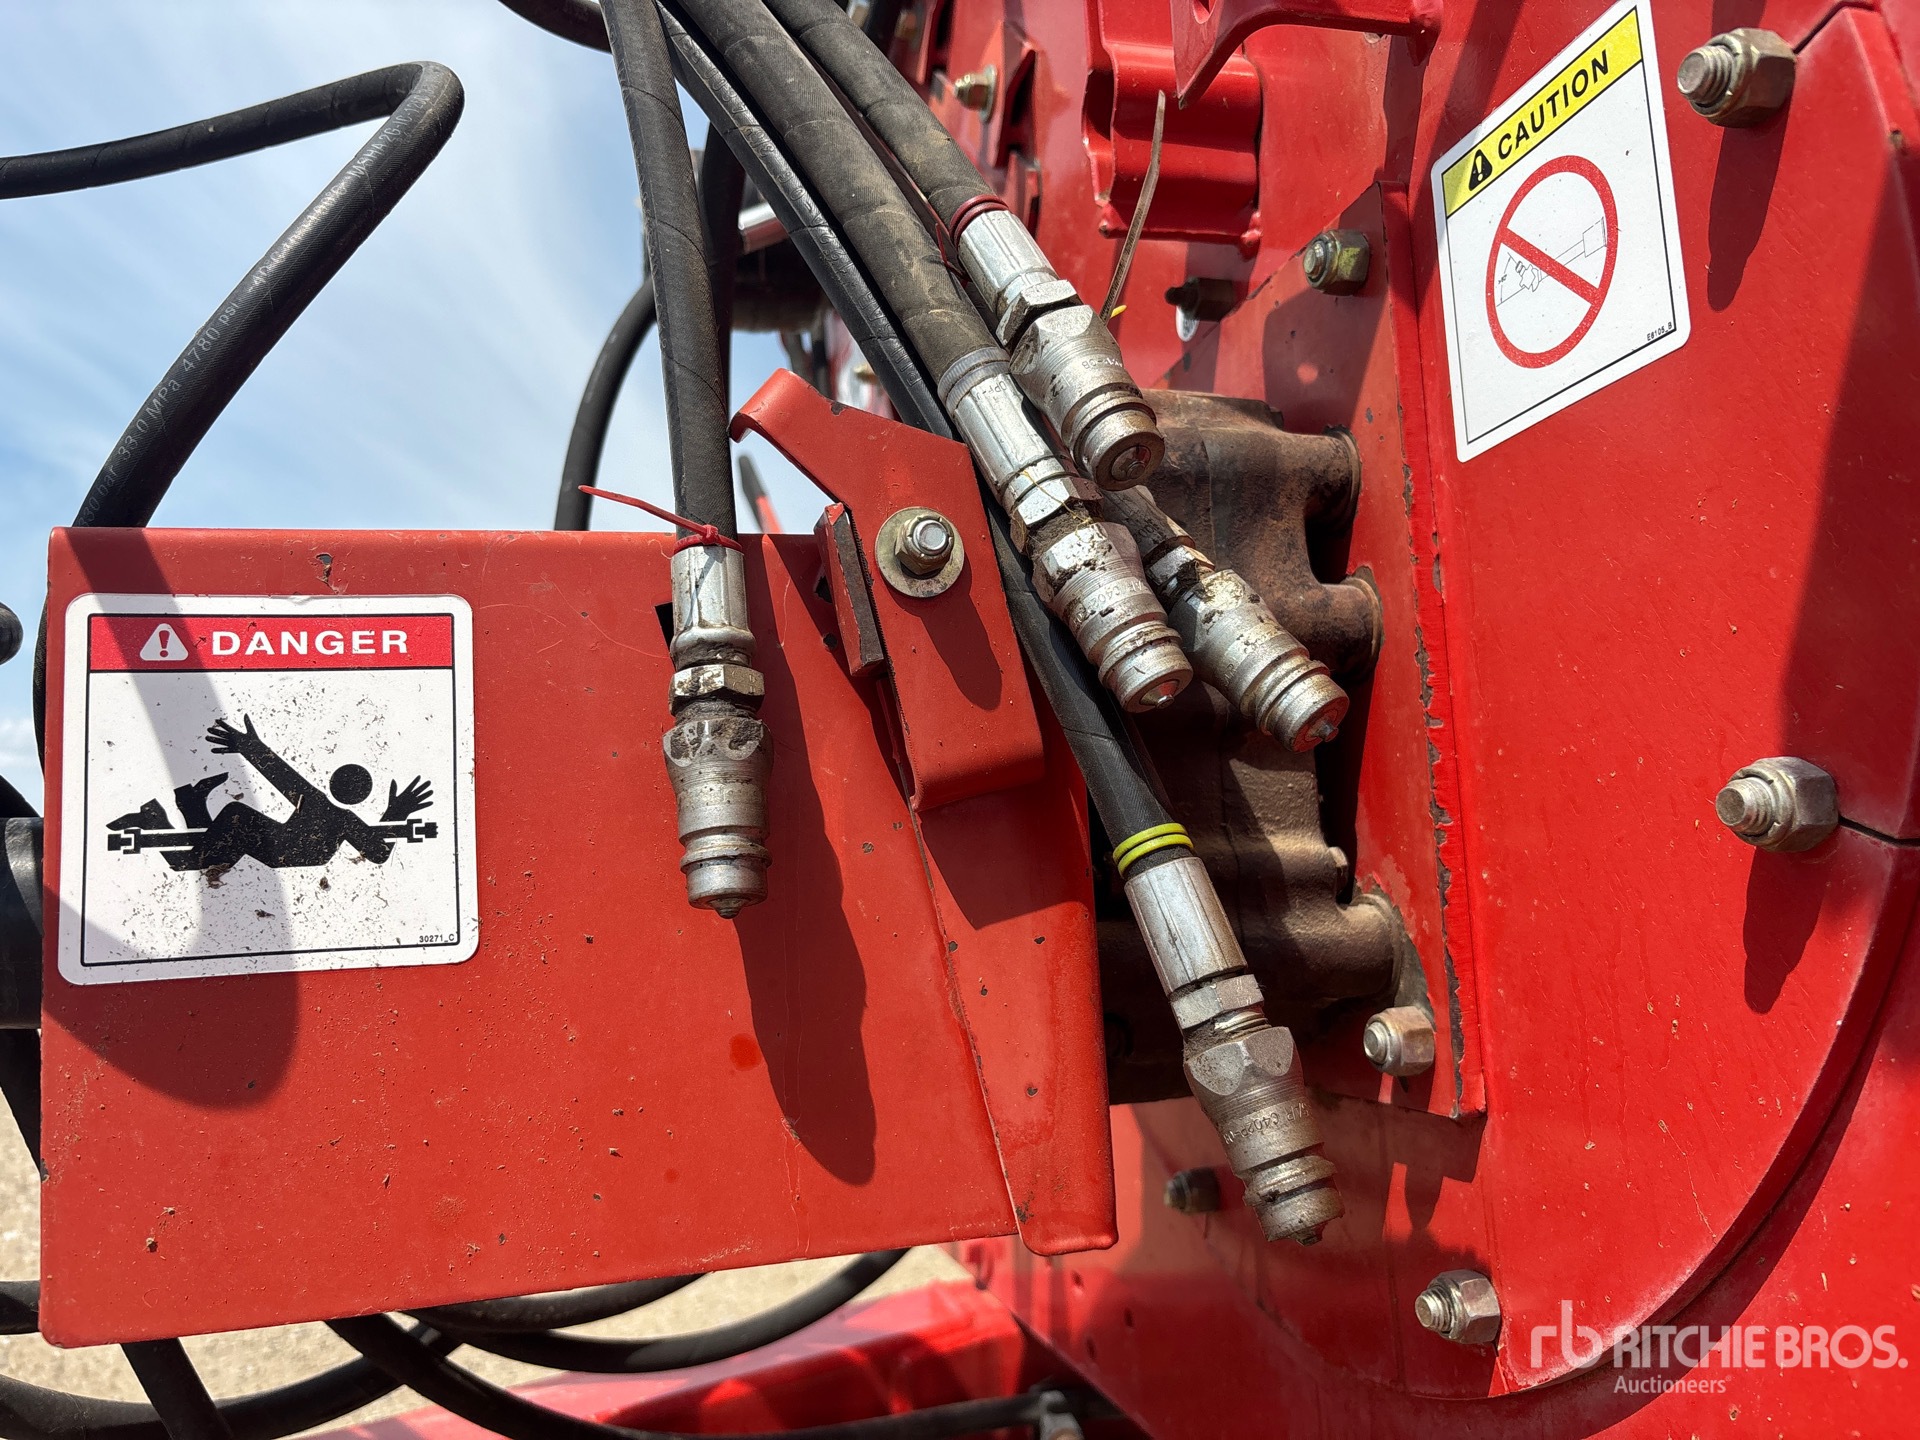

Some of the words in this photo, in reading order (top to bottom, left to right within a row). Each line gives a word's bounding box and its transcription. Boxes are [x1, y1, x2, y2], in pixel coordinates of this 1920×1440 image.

[1498, 50, 1608, 160] CAUTION
[98, 464, 119, 496] bar
[145, 379, 182, 419] MPa
[182, 327, 221, 372] 4780
[347, 142, 387, 178] MSHA
[212, 629, 408, 656] DANGER
[419, 933, 455, 943] 30271_C
